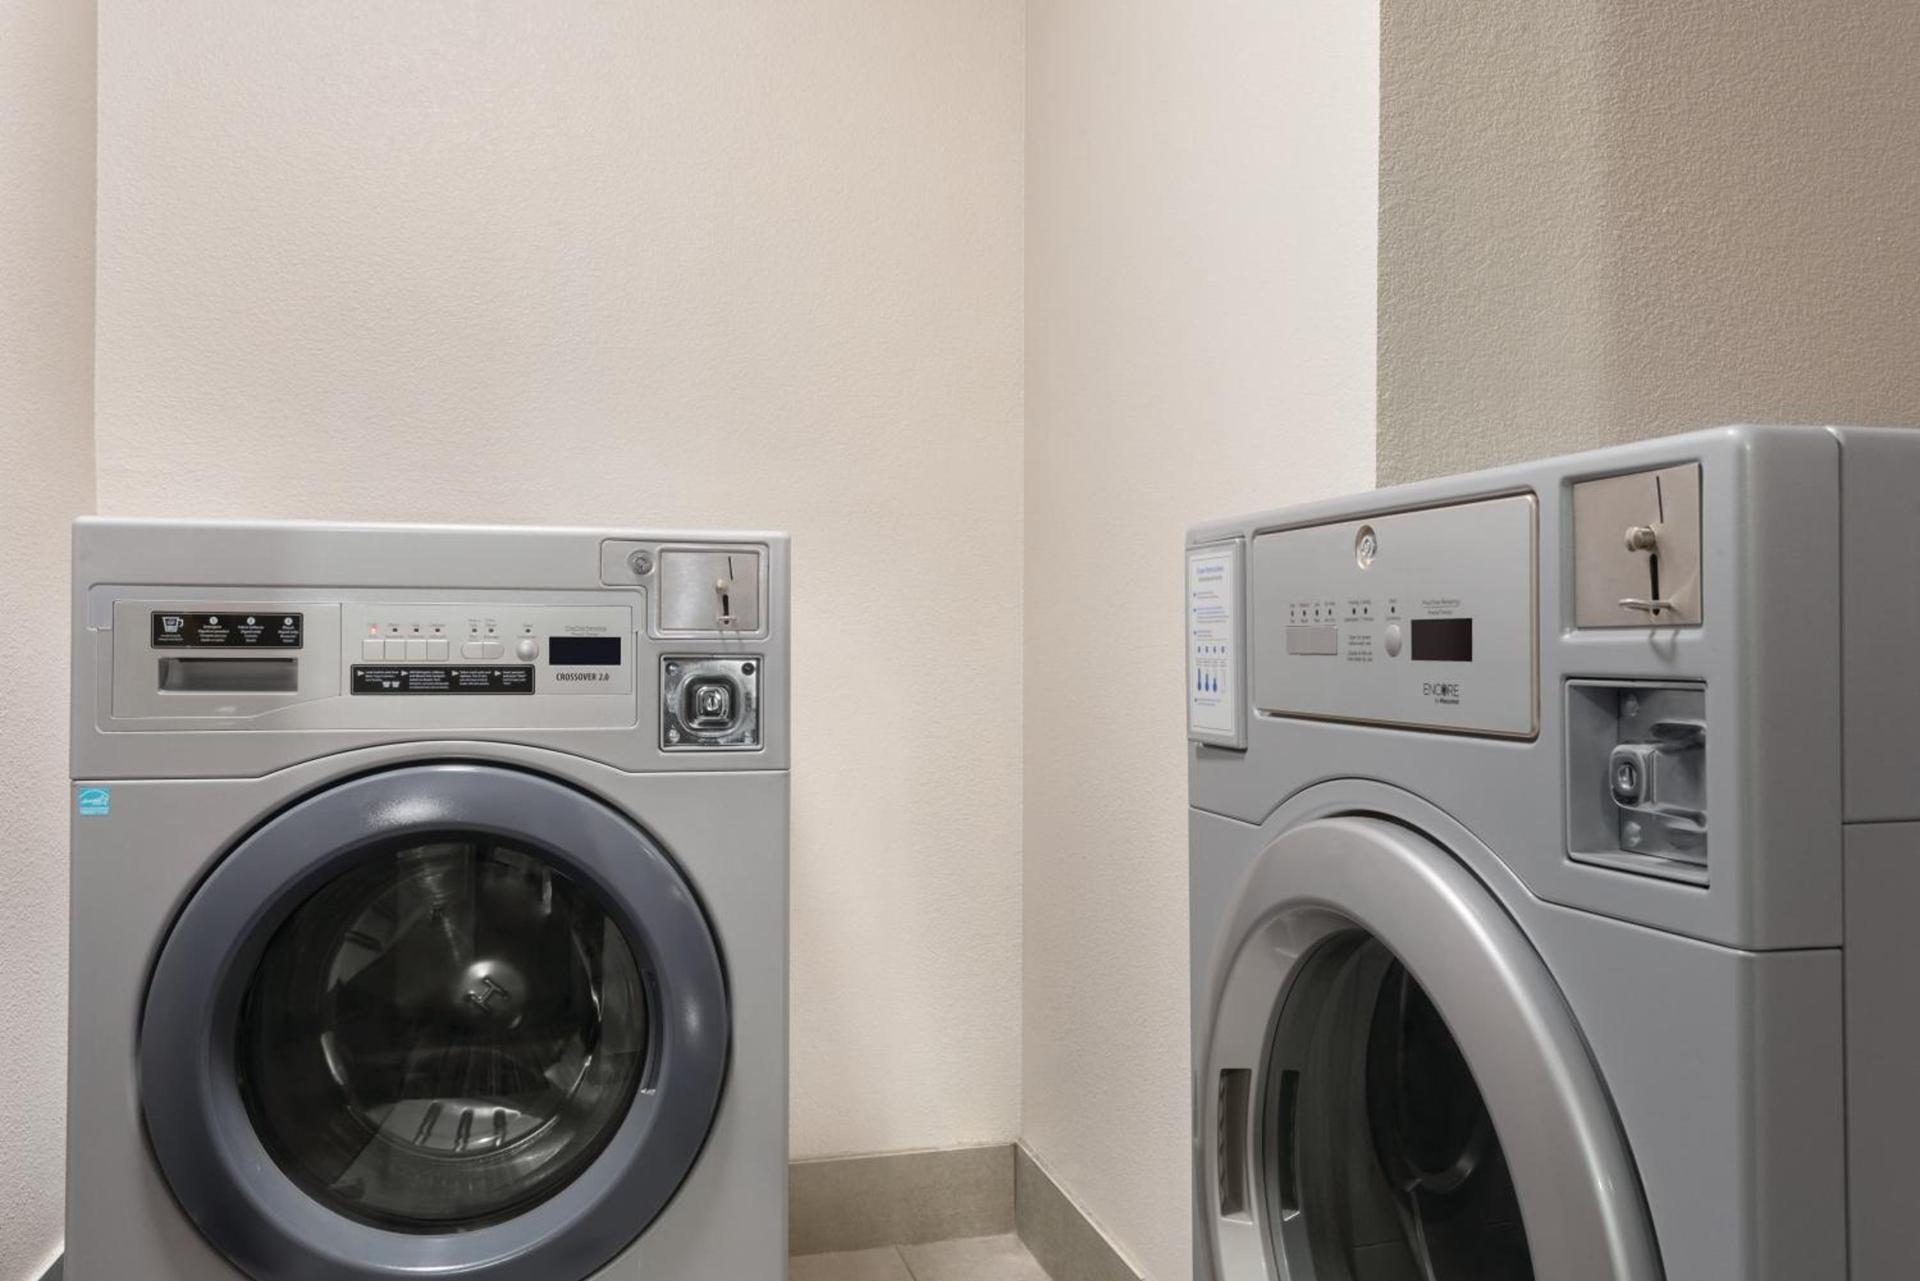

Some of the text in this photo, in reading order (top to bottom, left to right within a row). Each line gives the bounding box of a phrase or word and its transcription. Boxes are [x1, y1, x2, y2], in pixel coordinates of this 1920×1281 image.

[556, 672, 610, 681] CROSSOVER 2.0
[1423, 682, 1460, 697] ENCORE
